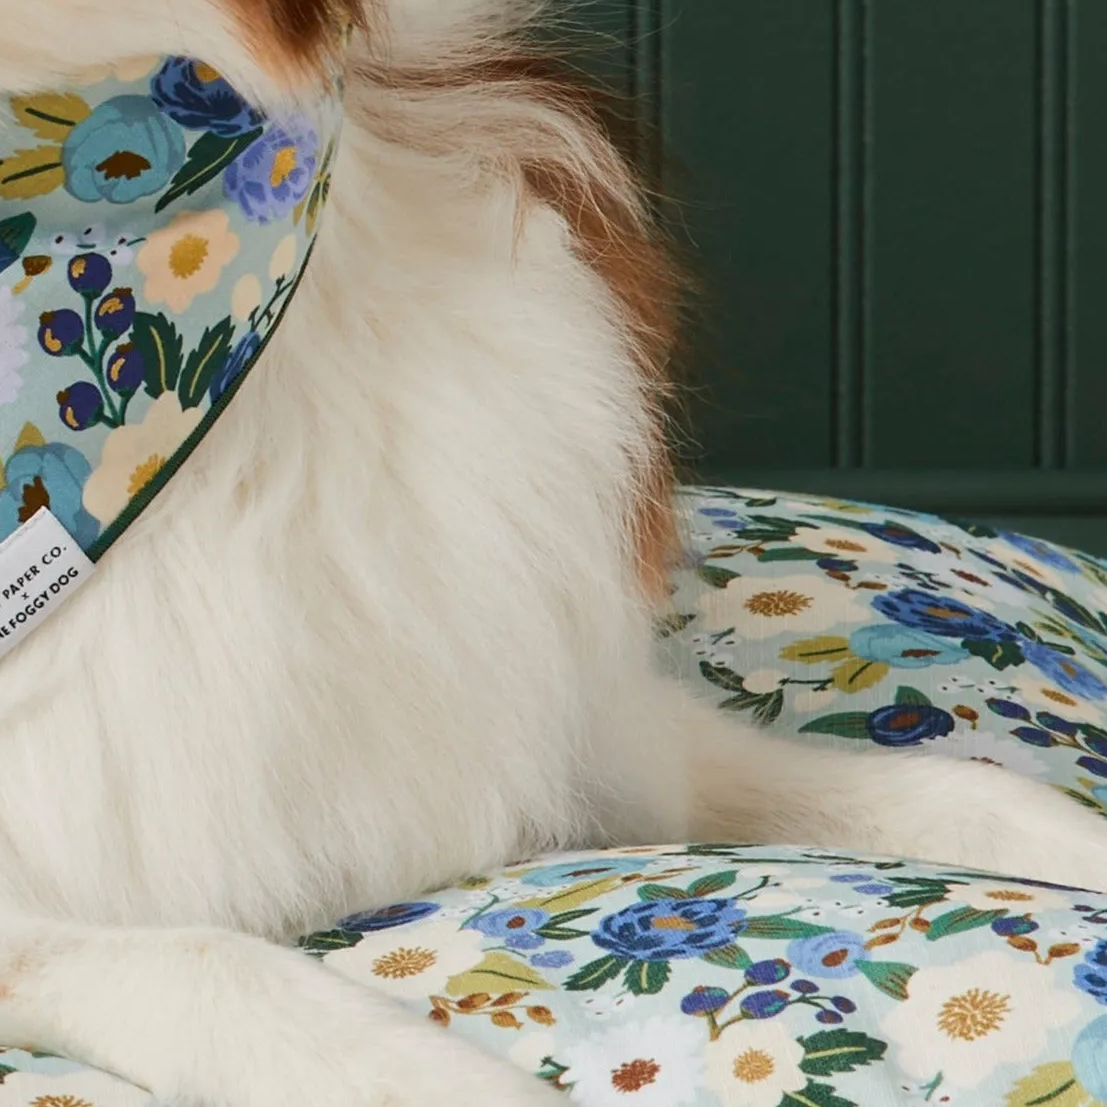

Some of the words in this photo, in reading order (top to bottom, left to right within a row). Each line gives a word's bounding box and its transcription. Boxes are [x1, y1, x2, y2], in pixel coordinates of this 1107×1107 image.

[2, 565, 40, 600] PAPER
[41, 546, 67, 565] CO.
[9, 590, 50, 629] FOGGY
[49, 567, 79, 594] DOG
[21, 592, 30, 600] x
